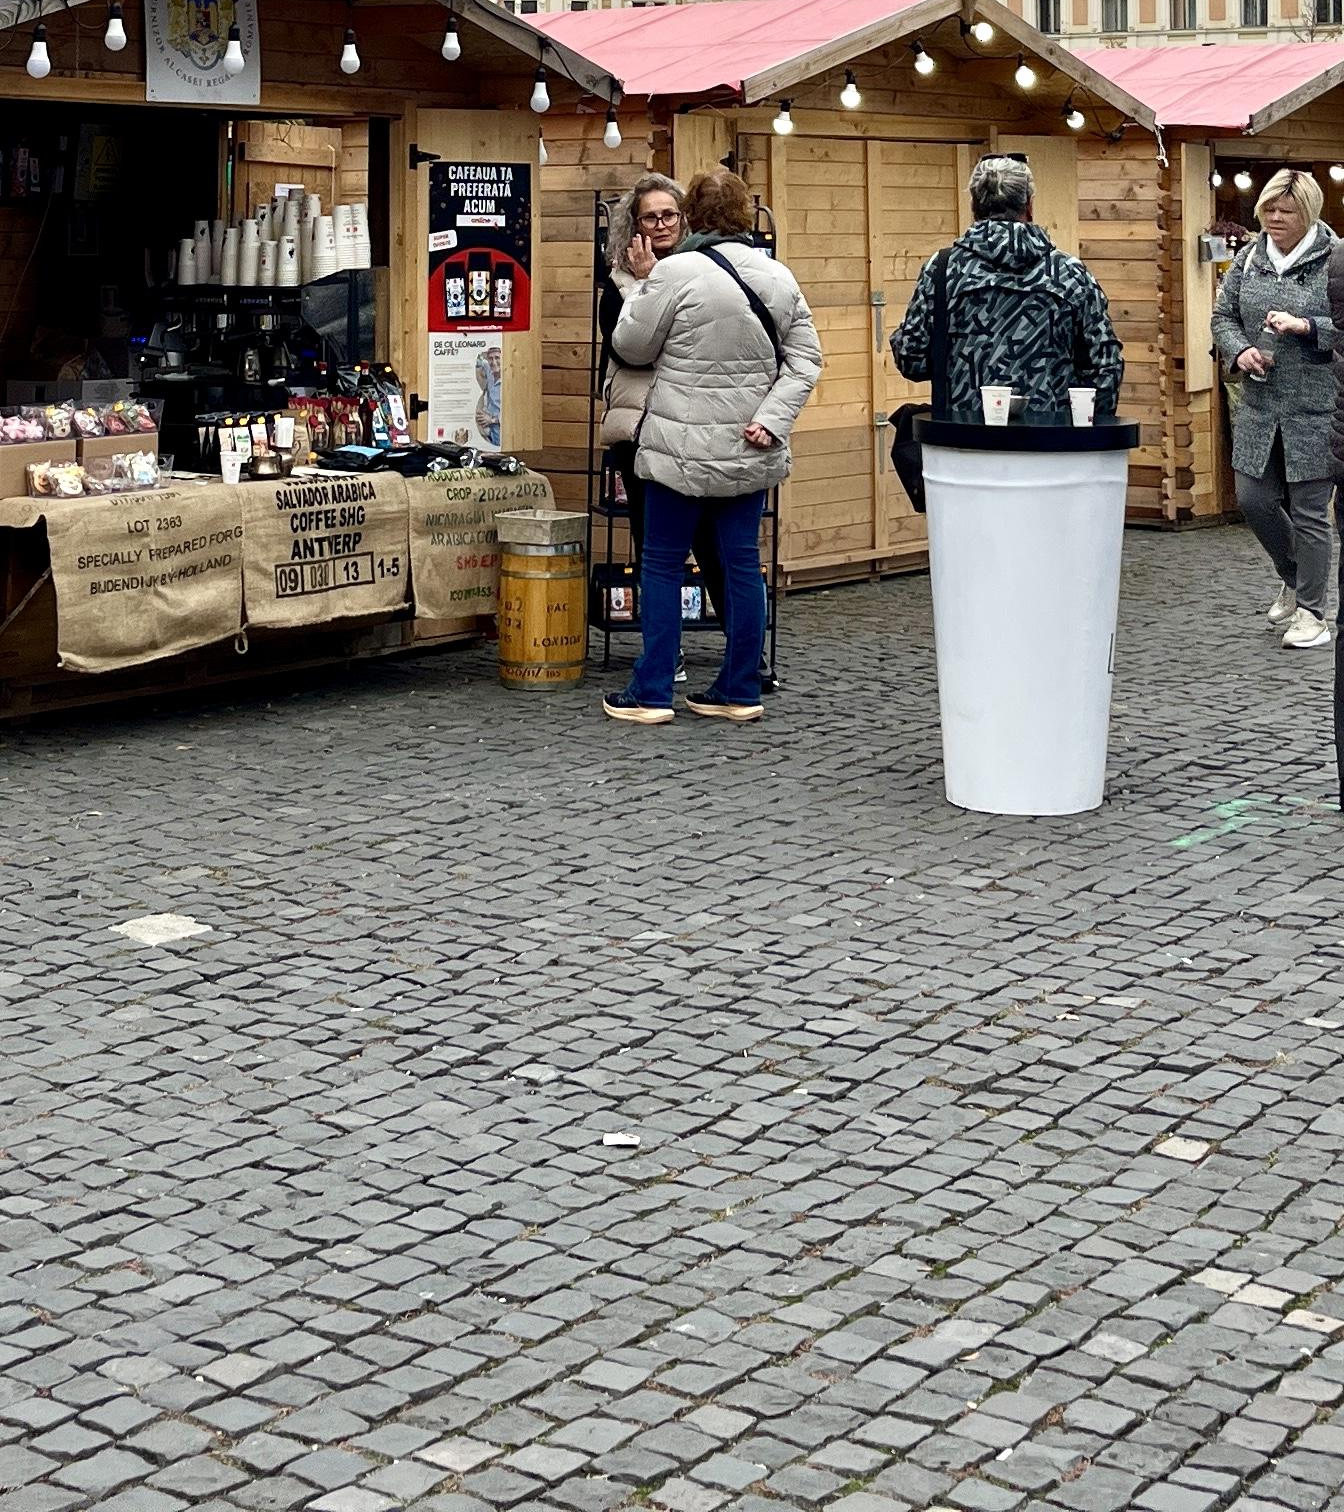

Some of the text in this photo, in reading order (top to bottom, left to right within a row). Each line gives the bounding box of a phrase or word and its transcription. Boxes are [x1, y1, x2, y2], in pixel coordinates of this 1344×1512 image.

[448, 165, 513, 181] CAFEAUA TA
[450, 180, 512, 197] PREFERATĂ
[463, 199, 496, 213] ACUM
[275, 480, 376, 510] SALVADOR ARABICA
[126, 519, 150, 534] LOT
[290, 505, 365, 533] COFFEE SHG
[77, 549, 143, 570] SPECIALLY
[148, 535, 207, 562] PREPARED
[208, 529, 232, 546] FOR
[278, 568, 300, 593] 09
[343, 561, 360, 582] 13
[377, 556, 400, 579] 1-5
